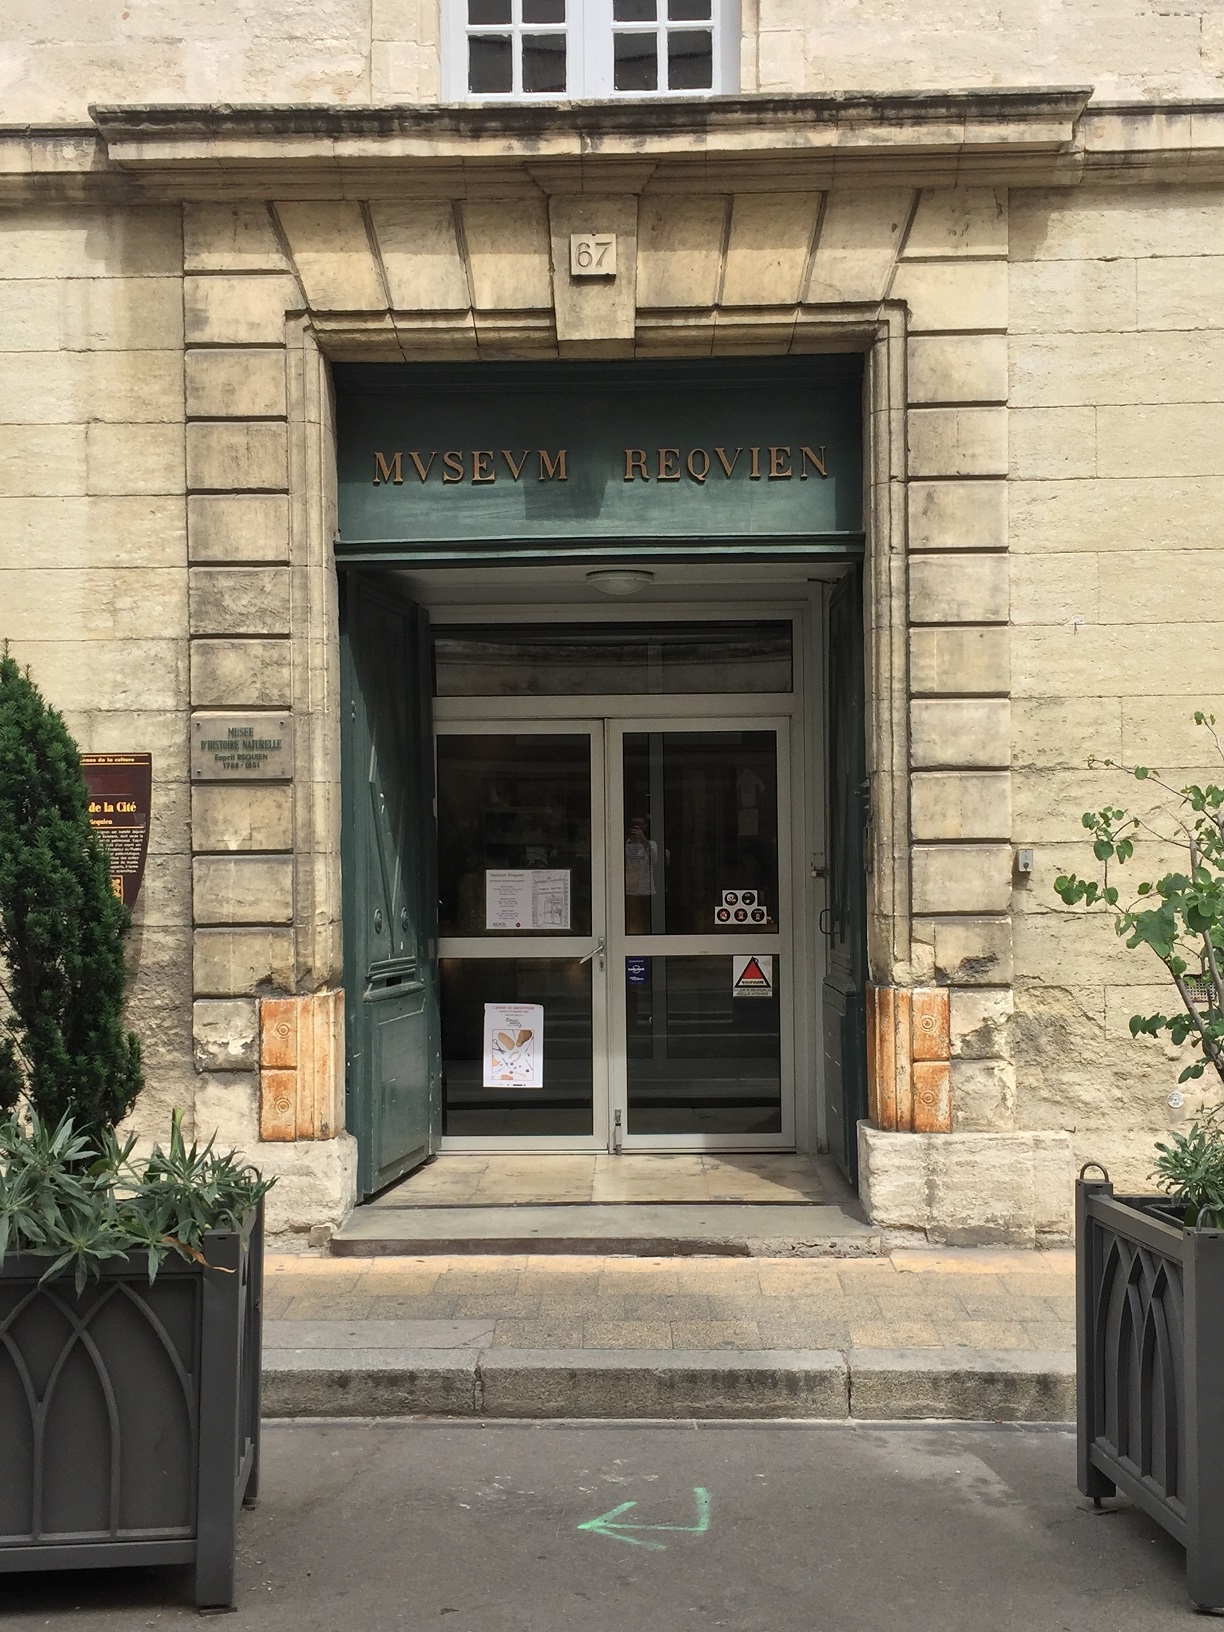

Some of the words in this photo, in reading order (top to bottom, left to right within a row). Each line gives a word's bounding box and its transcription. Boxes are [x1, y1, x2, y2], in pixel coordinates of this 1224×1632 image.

[575, 241, 613, 268] 67
[373, 449, 569, 483] MVSEVM
[624, 445, 828, 483] REQVIEN
[201, 739, 239, 751] D'HISTOIRE
[242, 739, 282, 750] NATURELLE
[214, 753, 235, 762] Esprit
[237, 753, 268, 761] REQUIEN
[88, 802, 101, 813] de
[103, 802, 114, 813] la
[116, 801, 137, 813] Cité
